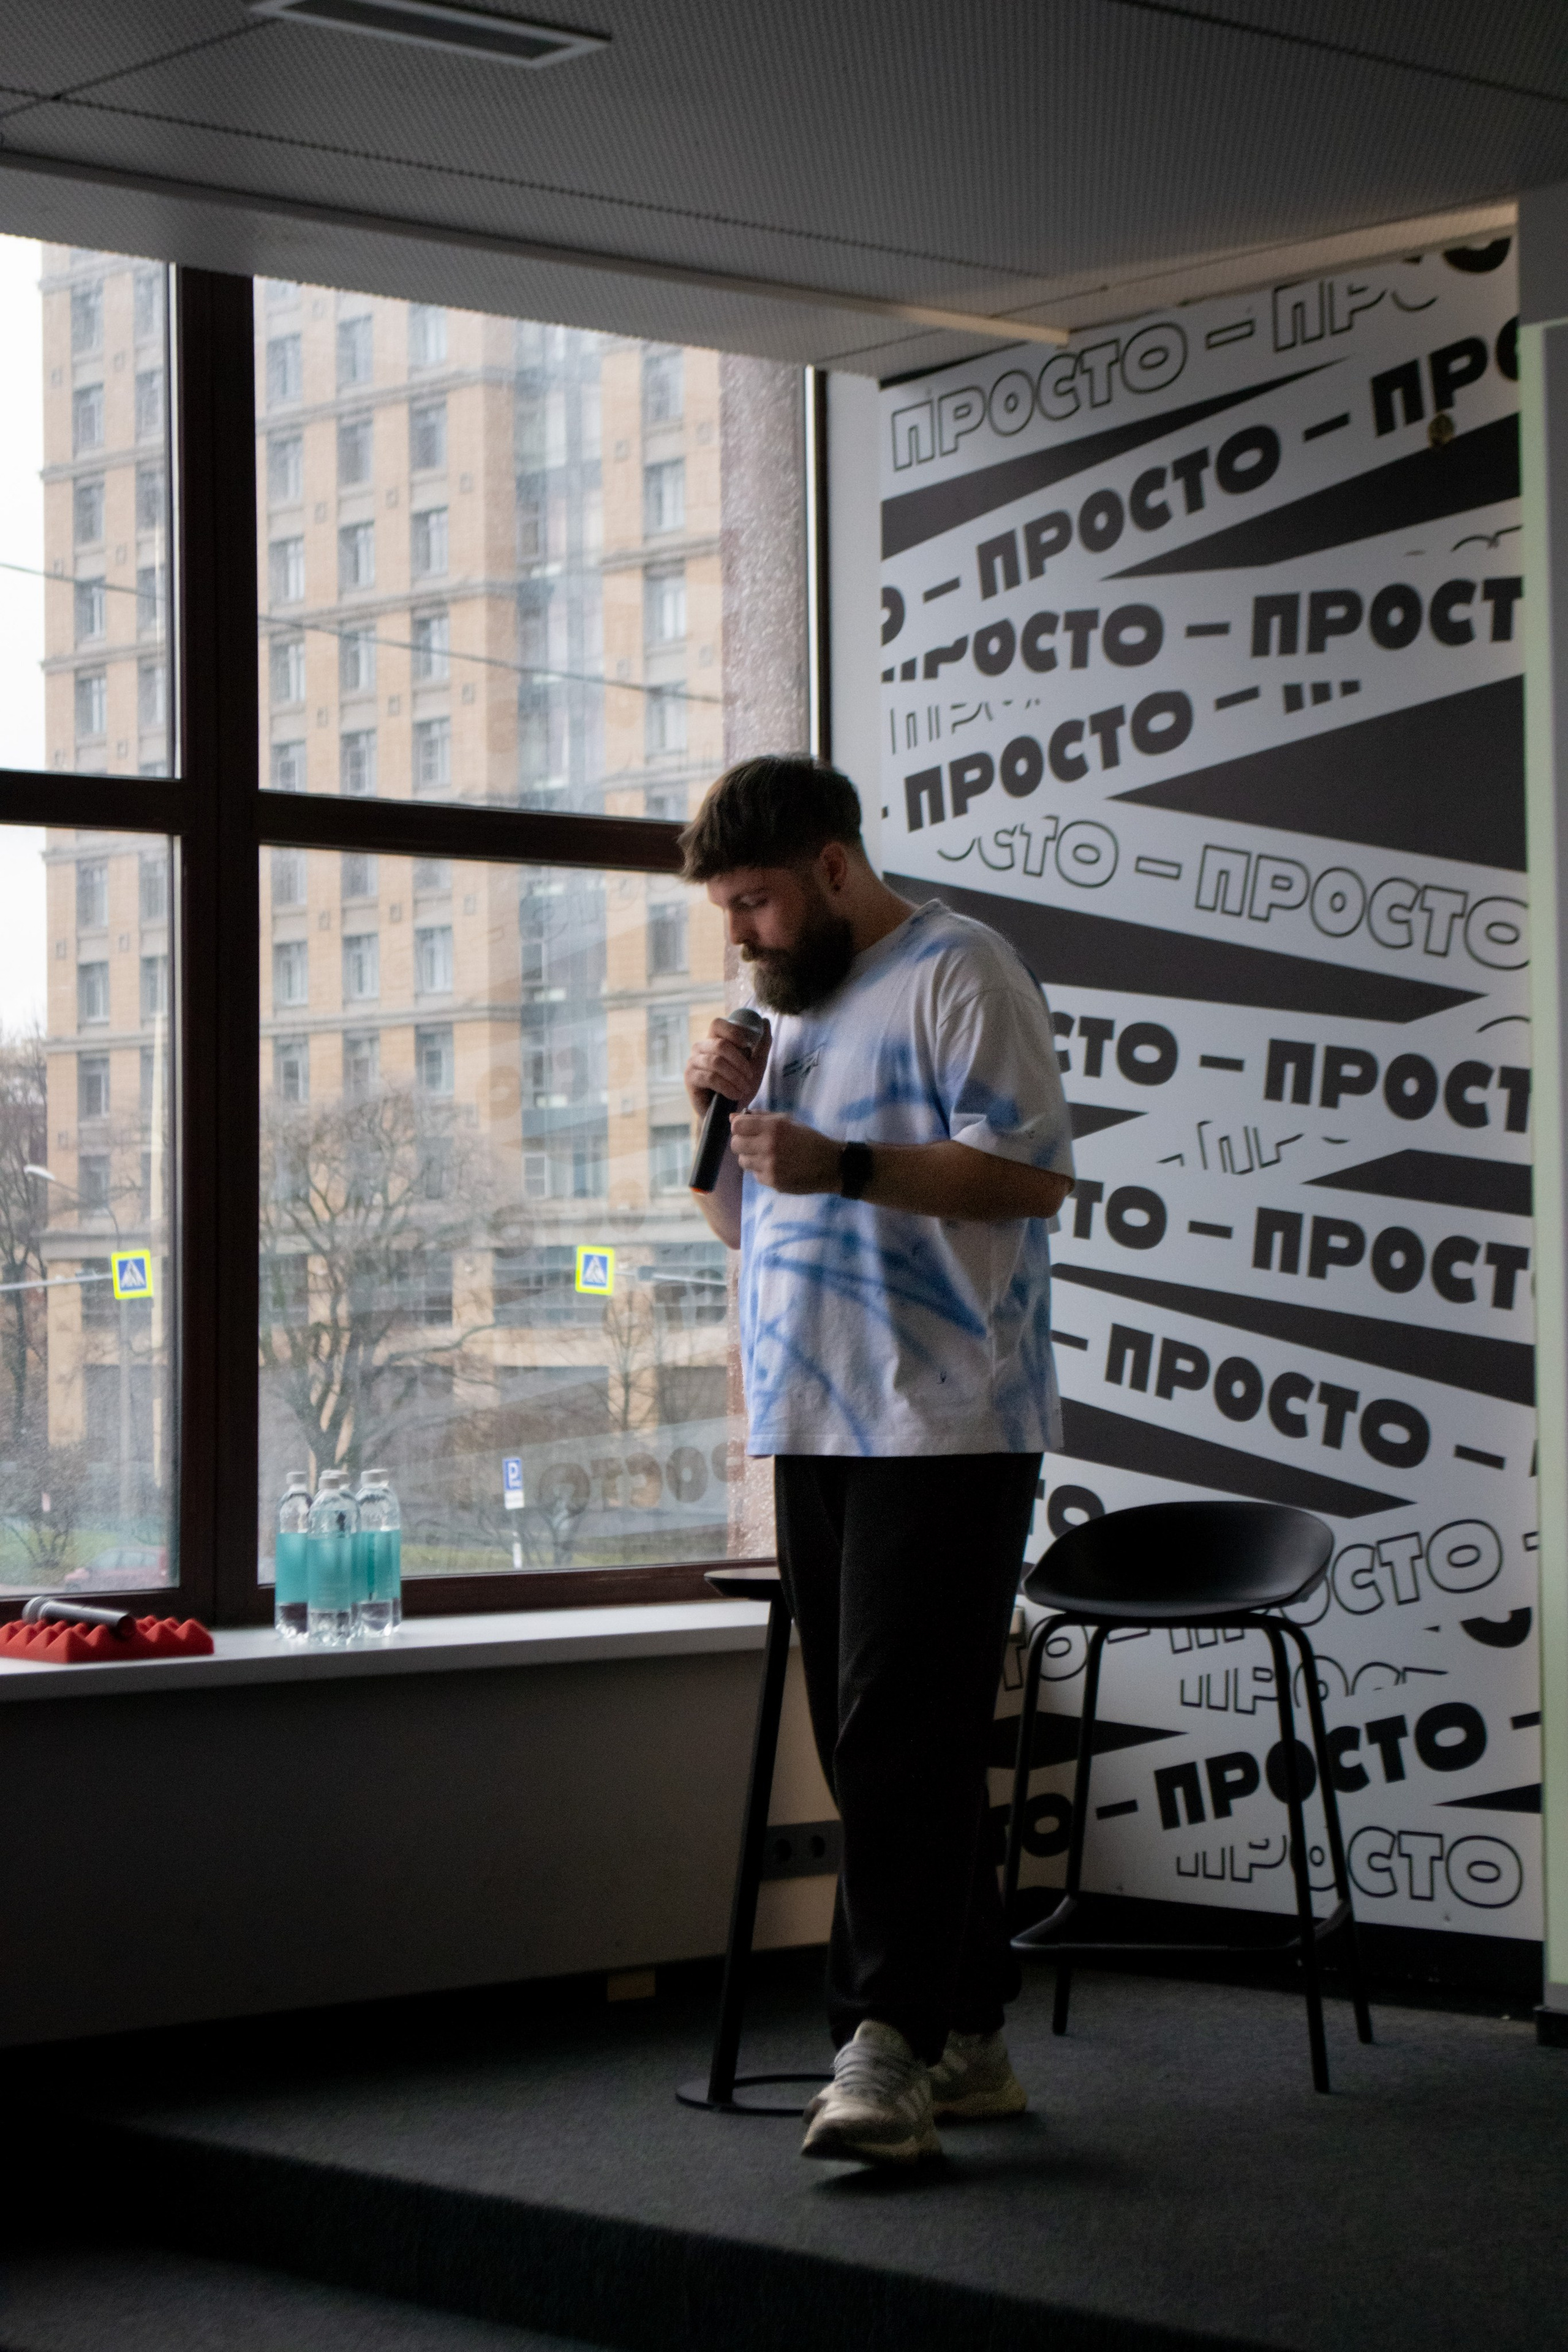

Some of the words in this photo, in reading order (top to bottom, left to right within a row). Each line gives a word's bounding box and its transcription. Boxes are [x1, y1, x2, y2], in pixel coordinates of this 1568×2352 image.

[892, 322, 1188, 471] ПРОСТО
[976, 425, 1281, 600] ПРОСТО
[1251, 576, 1523, 657] ПРОСТ
[904, 690, 1194, 833] ПРОСТО
[1196, 844, 1531, 971] ПРОСТО
[1263, 1038, 1531, 1134] ПРОСТ
[1251, 1207, 1536, 1311] ПРОСТ
[1105, 1322, 1431, 1469] ПРОСТО
[1153, 1702, 1488, 1831] ПРОСТО
